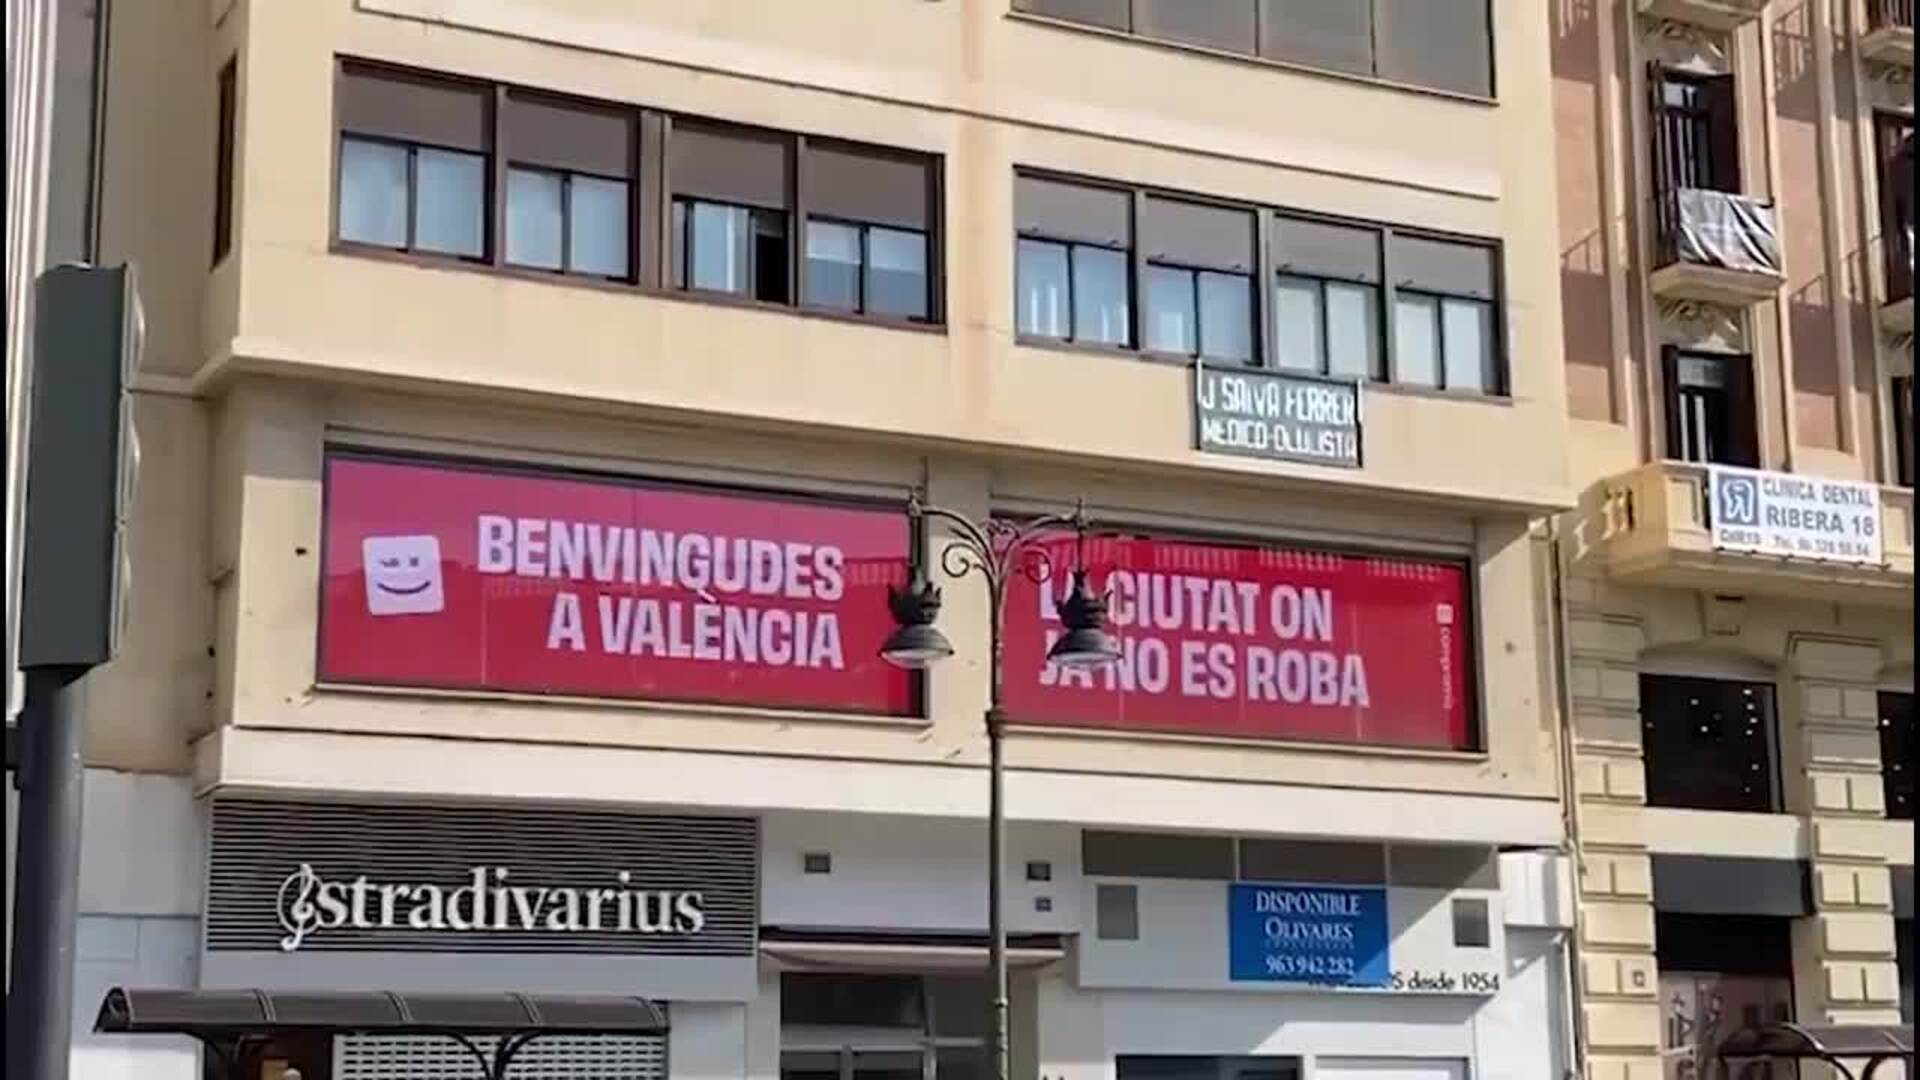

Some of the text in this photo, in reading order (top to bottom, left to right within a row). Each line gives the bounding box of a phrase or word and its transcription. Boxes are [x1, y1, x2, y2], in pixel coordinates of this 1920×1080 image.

[1221, 376, 1280, 418] SALVA
[1763, 478, 1873, 507] CLINICA DENTAL
[1766, 505, 1874, 537] RIBERA 18
[477, 514, 844, 602] BENVINGUDES
[1105, 568, 1260, 637] CIUTAT
[1270, 584, 1332, 642] ON
[547, 588, 845, 670] A VALÈNCIA
[1104, 636, 1170, 694] NO
[1181, 640, 1236, 699] ES
[1247, 646, 1371, 709] ROBA
[1256, 890, 1361, 917] DISPONIBLE
[1265, 955, 1354, 978] 963 942 282
[1408, 972, 1456, 991] desde
[1463, 971, 1500, 992] 1954
